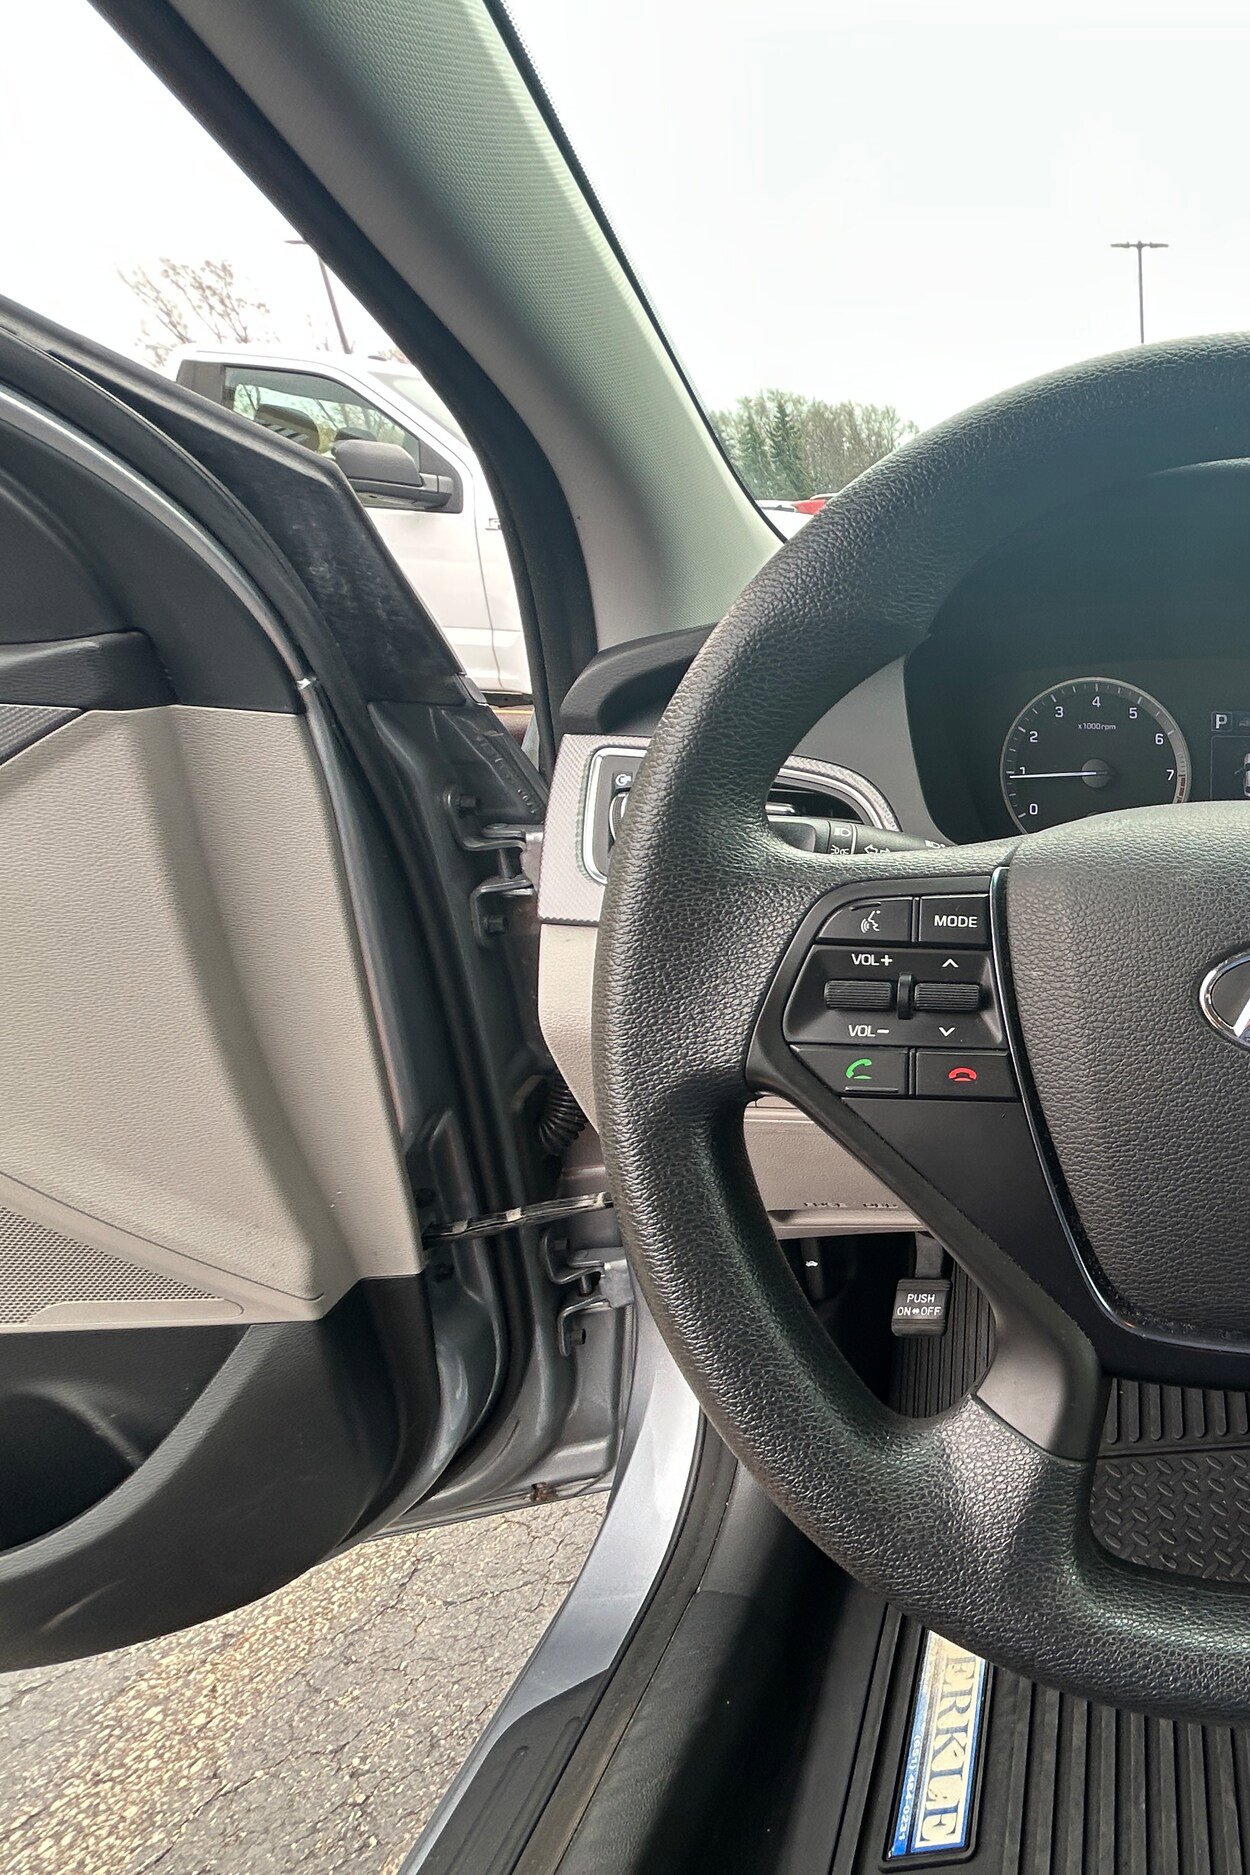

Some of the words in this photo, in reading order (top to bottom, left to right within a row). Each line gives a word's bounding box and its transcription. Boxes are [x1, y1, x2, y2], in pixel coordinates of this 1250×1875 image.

[1092, 696, 1101, 708] 4
[1055, 706, 1064, 718] 3
[1129, 707, 1138, 719] 5
[1215, 713, 1228, 729] P
[1029, 731, 1038, 743] 2
[1155, 733, 1164, 745] 6
[1166, 769, 1175, 781] 7
[1029, 803, 1038, 815] 0
[933, 915, 978, 928] MODE
[906, 1293, 936, 1303] PUSH
[919, 1656, 977, 1842] ERKLE
